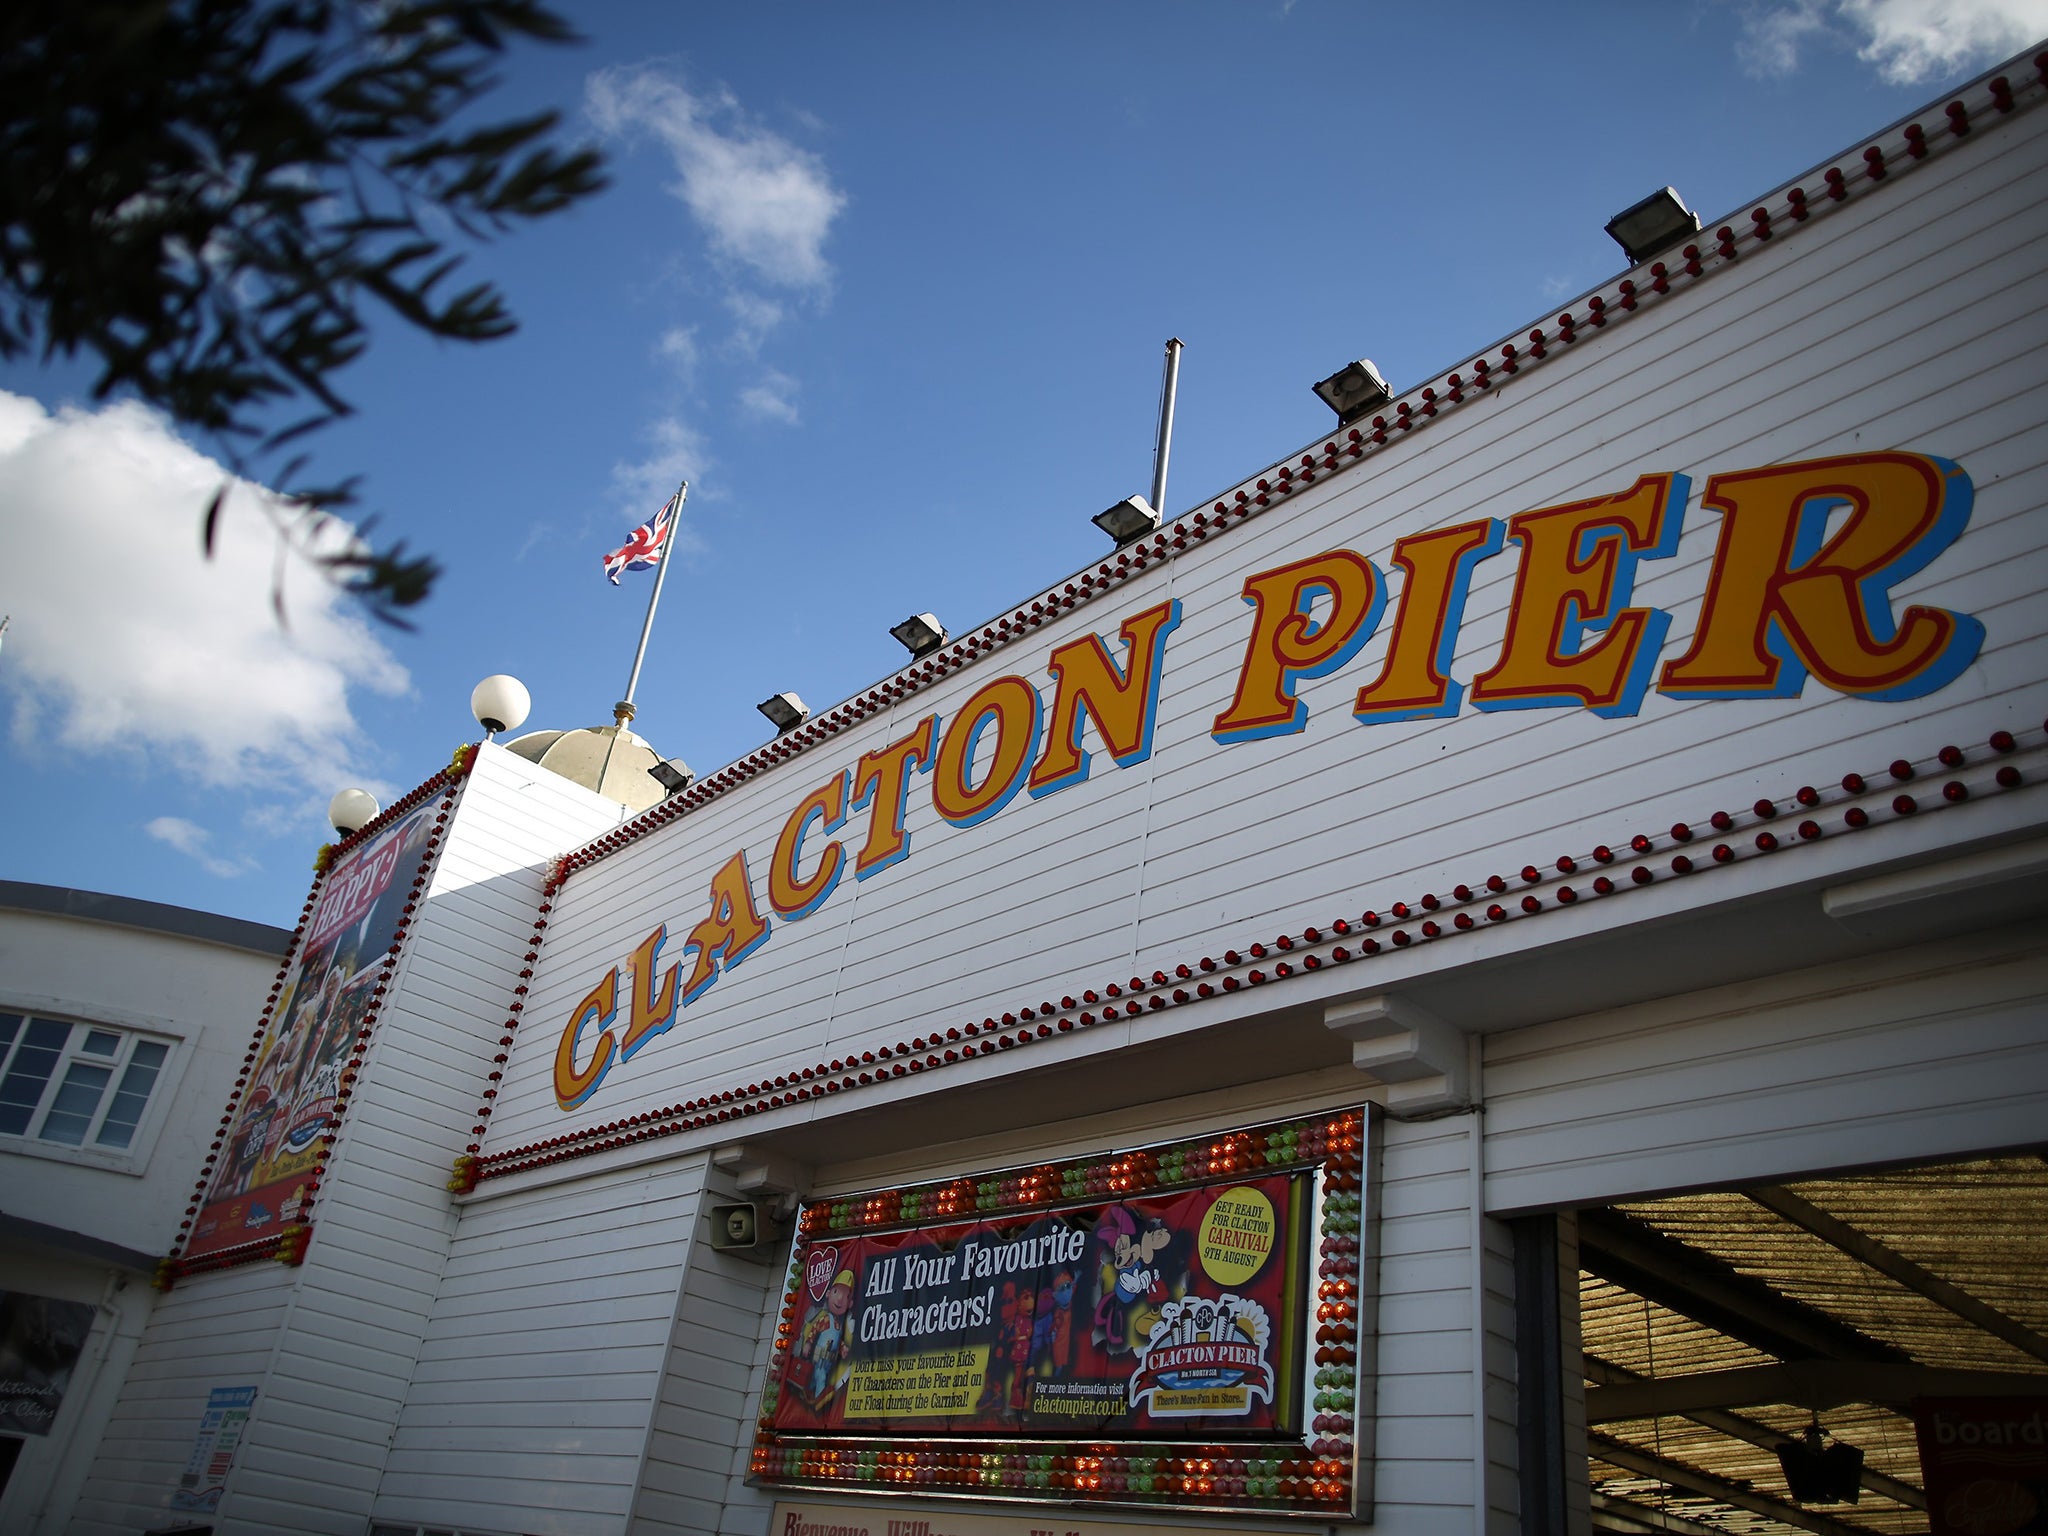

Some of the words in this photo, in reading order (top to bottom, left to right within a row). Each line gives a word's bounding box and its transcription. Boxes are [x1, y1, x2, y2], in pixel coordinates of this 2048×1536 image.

[554, 598, 1182, 1111] CLACTON
[1210, 450, 1986, 745] PIER
[310, 850, 389, 942] HAPPY
[1215, 1200, 1235, 1213] GET
[1234, 1203, 1265, 1218] READY
[1212, 1213, 1230, 1227] FOR
[1231, 1216, 1270, 1233] CLACTON
[1208, 1226, 1269, 1253] CARNIVAL
[864, 1257, 897, 1297] All
[902, 1253, 956, 1290] Your
[961, 1224, 1085, 1281] Favourite
[1204, 1246, 1222, 1260] 9TH
[1222, 1250, 1258, 1267] AUGUST
[810, 1258, 833, 1279] LOVE
[861, 1286, 994, 1342] Characters!
[877, 1359, 894, 1371] miss
[895, 1358, 916, 1374] your
[917, 1352, 955, 1369] favourite
[957, 1351, 976, 1367] Kids
[1148, 1346, 1215, 1371] CLACTON
[1217, 1345, 1258, 1366] PIER
[852, 1377, 864, 1391] TV
[864, 1376, 905, 1391] Characters
[906, 1379, 917, 1389] on
[918, 1373, 932, 1389] the
[933, 1372, 951, 1388] Pier
[952, 1371, 969, 1387] and
[970, 1373, 982, 1386] on
[1035, 1382, 1047, 1394] For
[1048, 1384, 1066, 1394] more
[1067, 1382, 1107, 1395] information
[1109, 1383, 1124, 1395] visit
[849, 1398, 863, 1411] our
[864, 1395, 885, 1410] Float
[886, 1394, 914, 1413] during
[915, 1393, 929, 1409] the
[930, 1391, 970, 1409] Carnival!
[1033, 1395, 1128, 1418] clactonpier.co.uk
[1157, 1394, 1179, 1406] There's
[1180, 1394, 1197, 1405] More
[1211, 1393, 1219, 1403] in
[1933, 1411, 2048, 1445] board
